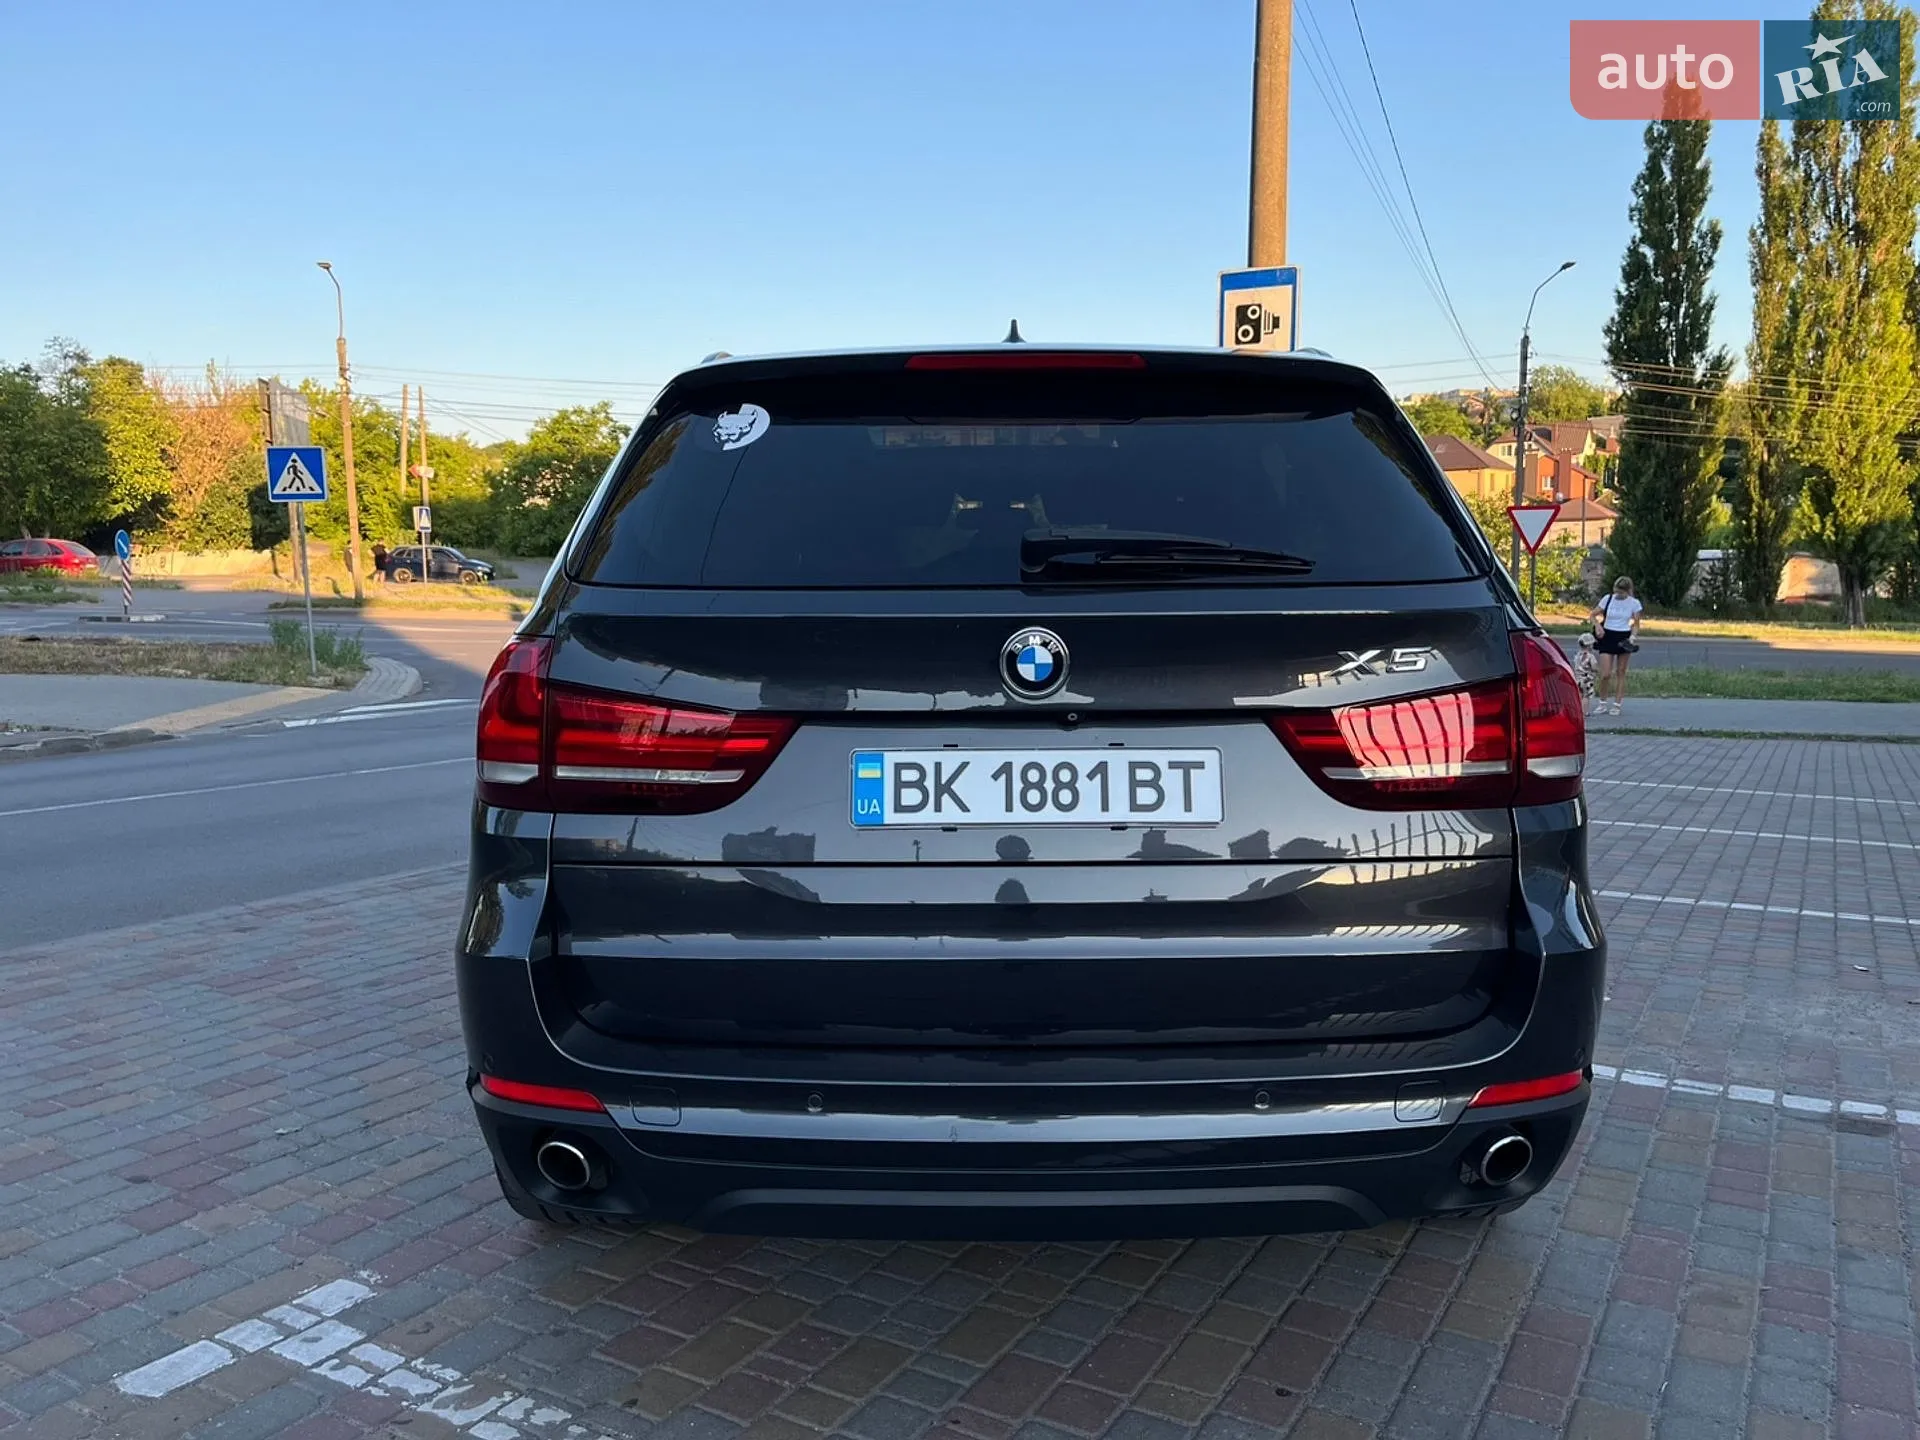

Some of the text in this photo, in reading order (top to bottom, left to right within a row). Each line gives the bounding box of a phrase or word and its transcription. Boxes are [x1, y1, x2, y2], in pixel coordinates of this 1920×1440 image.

[1011, 635, 1061, 655] BMW
[893, 761, 1205, 814] BK 1881 BT
[857, 798, 881, 815] UA
